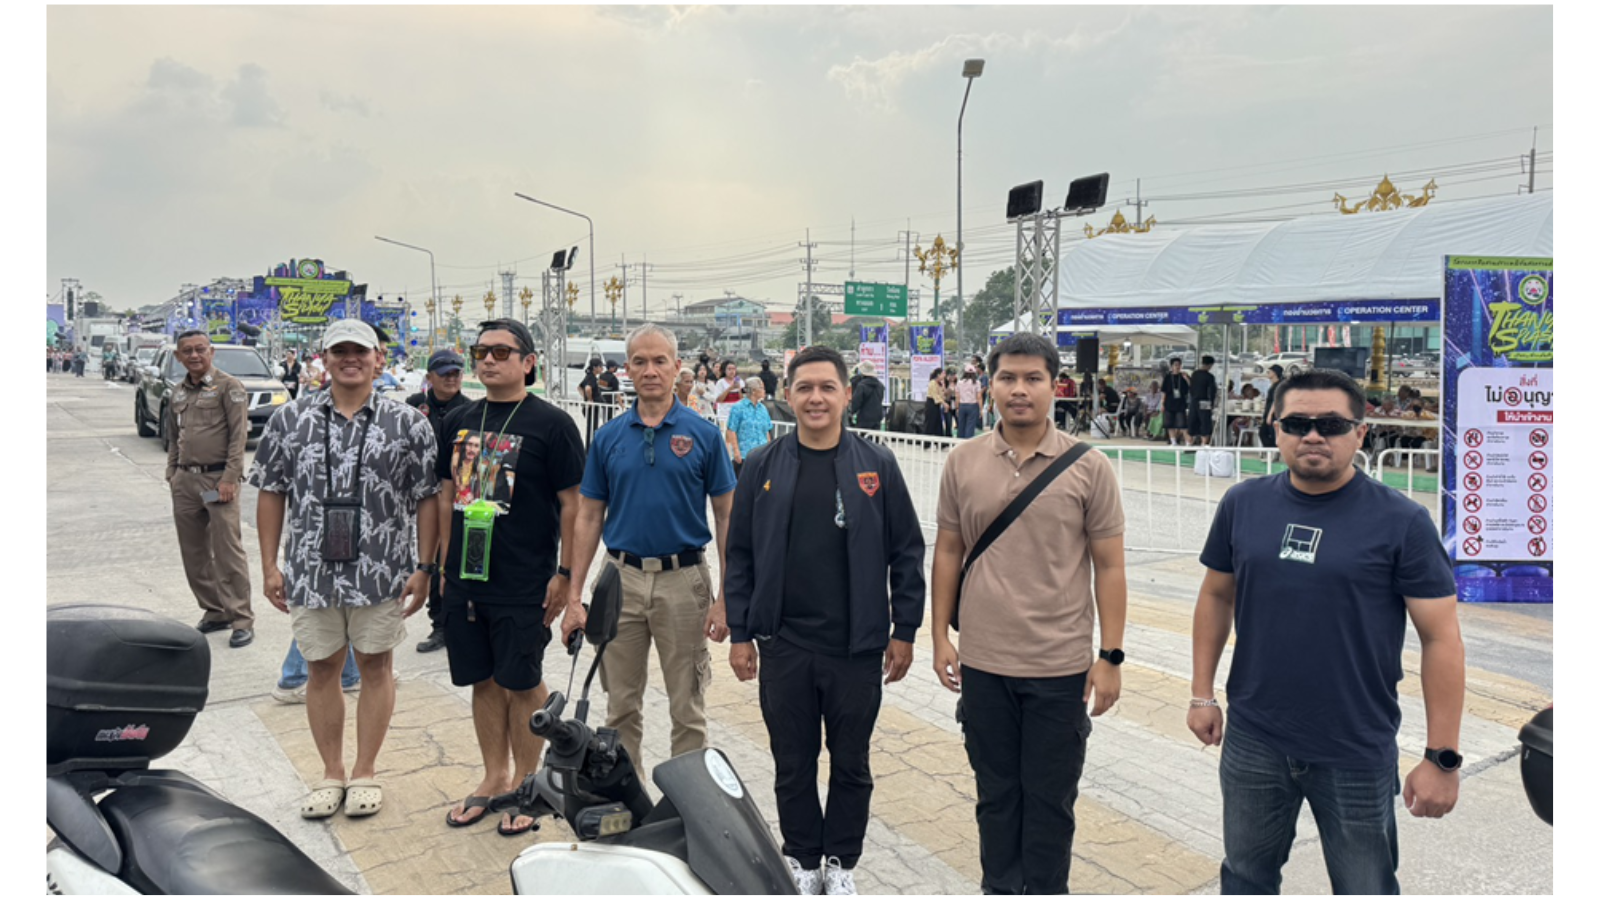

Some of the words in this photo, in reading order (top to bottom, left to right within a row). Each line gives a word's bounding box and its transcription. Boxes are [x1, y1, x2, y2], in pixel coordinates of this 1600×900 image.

[1112, 312, 1143, 320] OPERATION
[1344, 306, 1391, 315] OPERATION
[1394, 306, 1428, 314] CENTER
[1519, 374, 1538, 387] สิ่งที่
[1485, 385, 1553, 408] ไม่อนุญ
